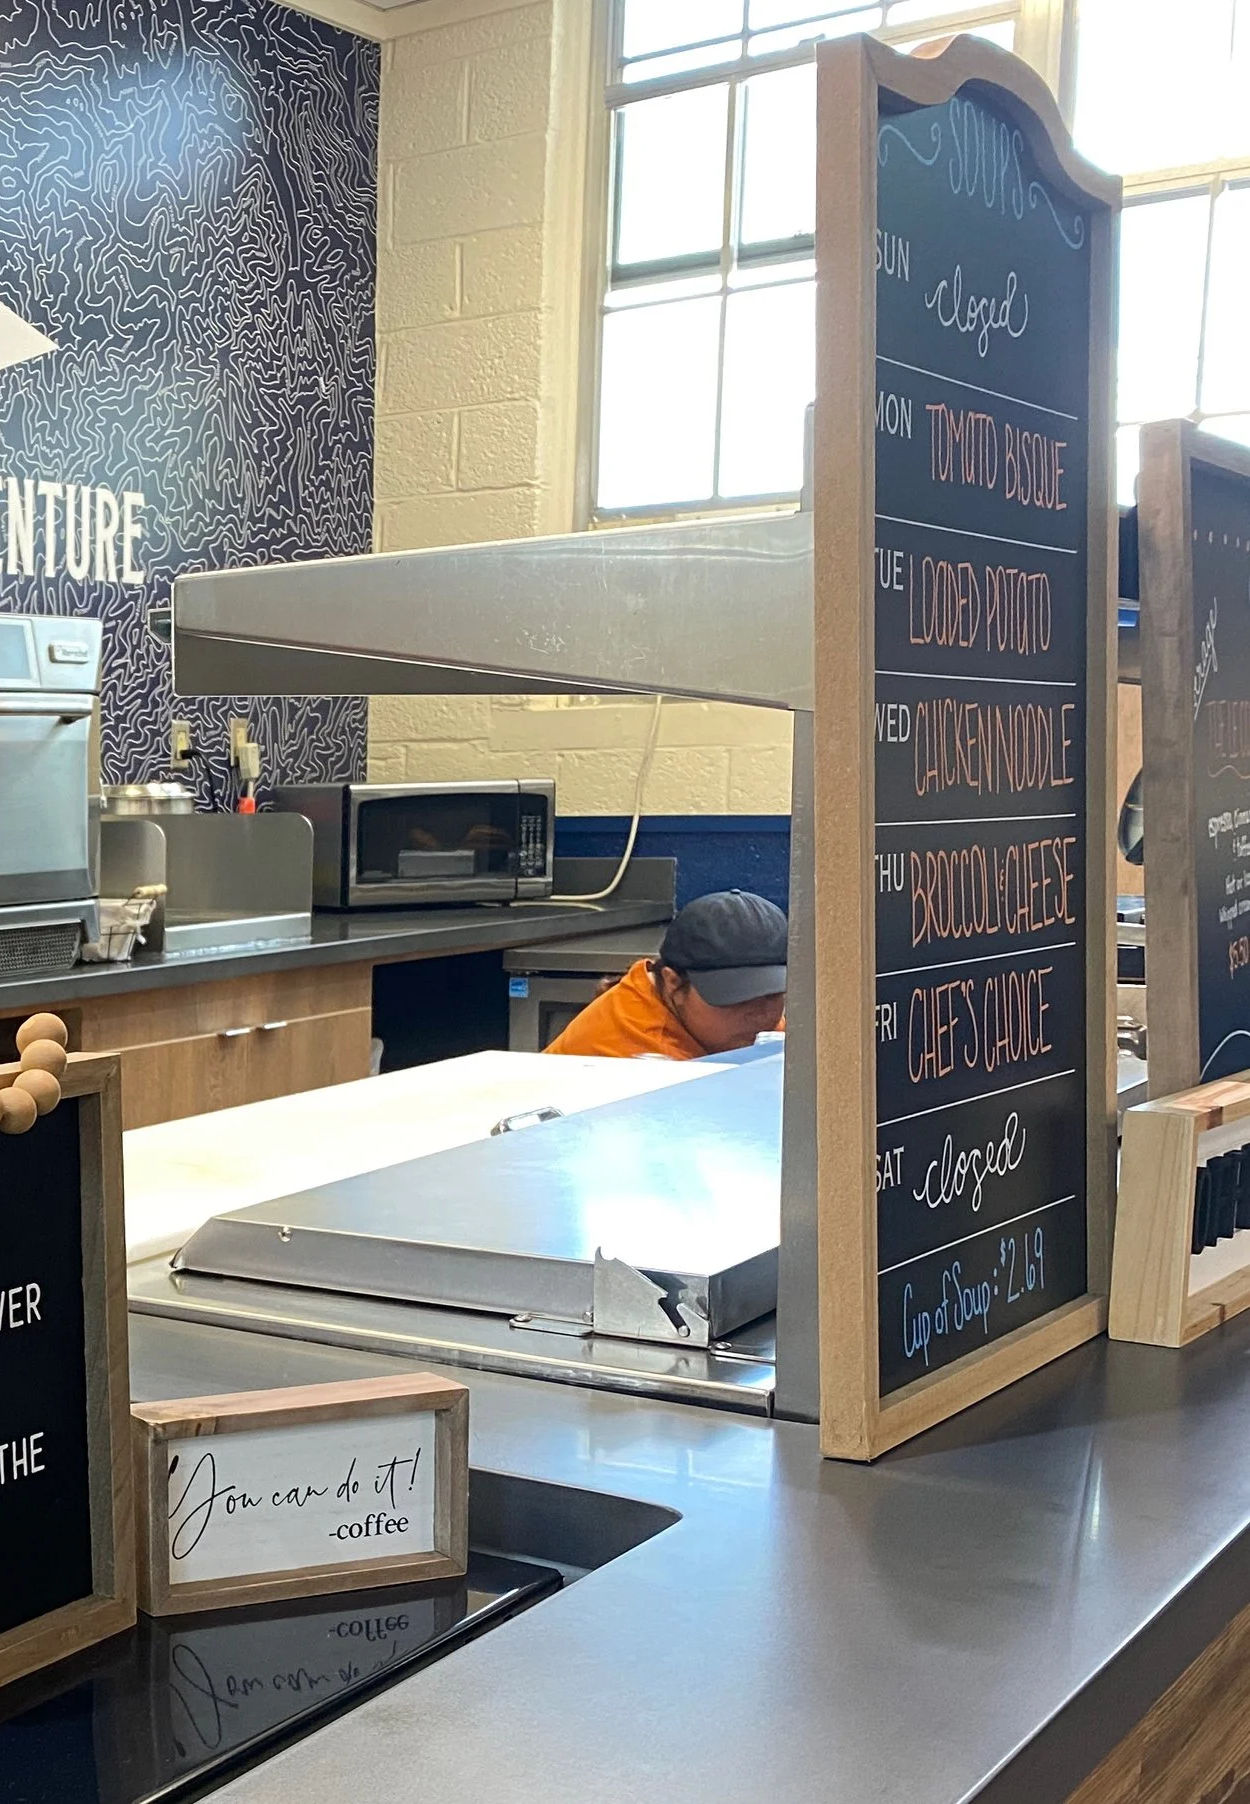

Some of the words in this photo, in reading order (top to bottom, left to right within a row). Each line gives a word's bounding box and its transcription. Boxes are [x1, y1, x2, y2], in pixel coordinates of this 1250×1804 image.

[949, 98, 1024, 220] SOUPS
[1005, 423, 1067, 511] BISQUE
[875, 548, 904, 590] UE
[914, 698, 992, 796] CHICKEN
[996, 703, 1075, 795] NOODLE
[875, 852, 904, 892] HU
[910, 844, 1001, 948] BROCCOLI
[1004, 837, 1076, 934] CHEESE
[909, 978, 978, 1083] CHEF'S
[983, 967, 1053, 1072] CHOICE
[904, 1283, 930, 1366] Cup
[935, 1270, 951, 1334] of
[952, 1261, 998, 1334] Soup:
[1000, 1227, 1044, 1303] $2.69
[168, 1453, 262, 1560] You
[272, 1485, 329, 1507] can
[337, 1457, 359, 1502] do
[374, 1448, 422, 1509] it!
[328, 1512, 409, 1541] -coffee
